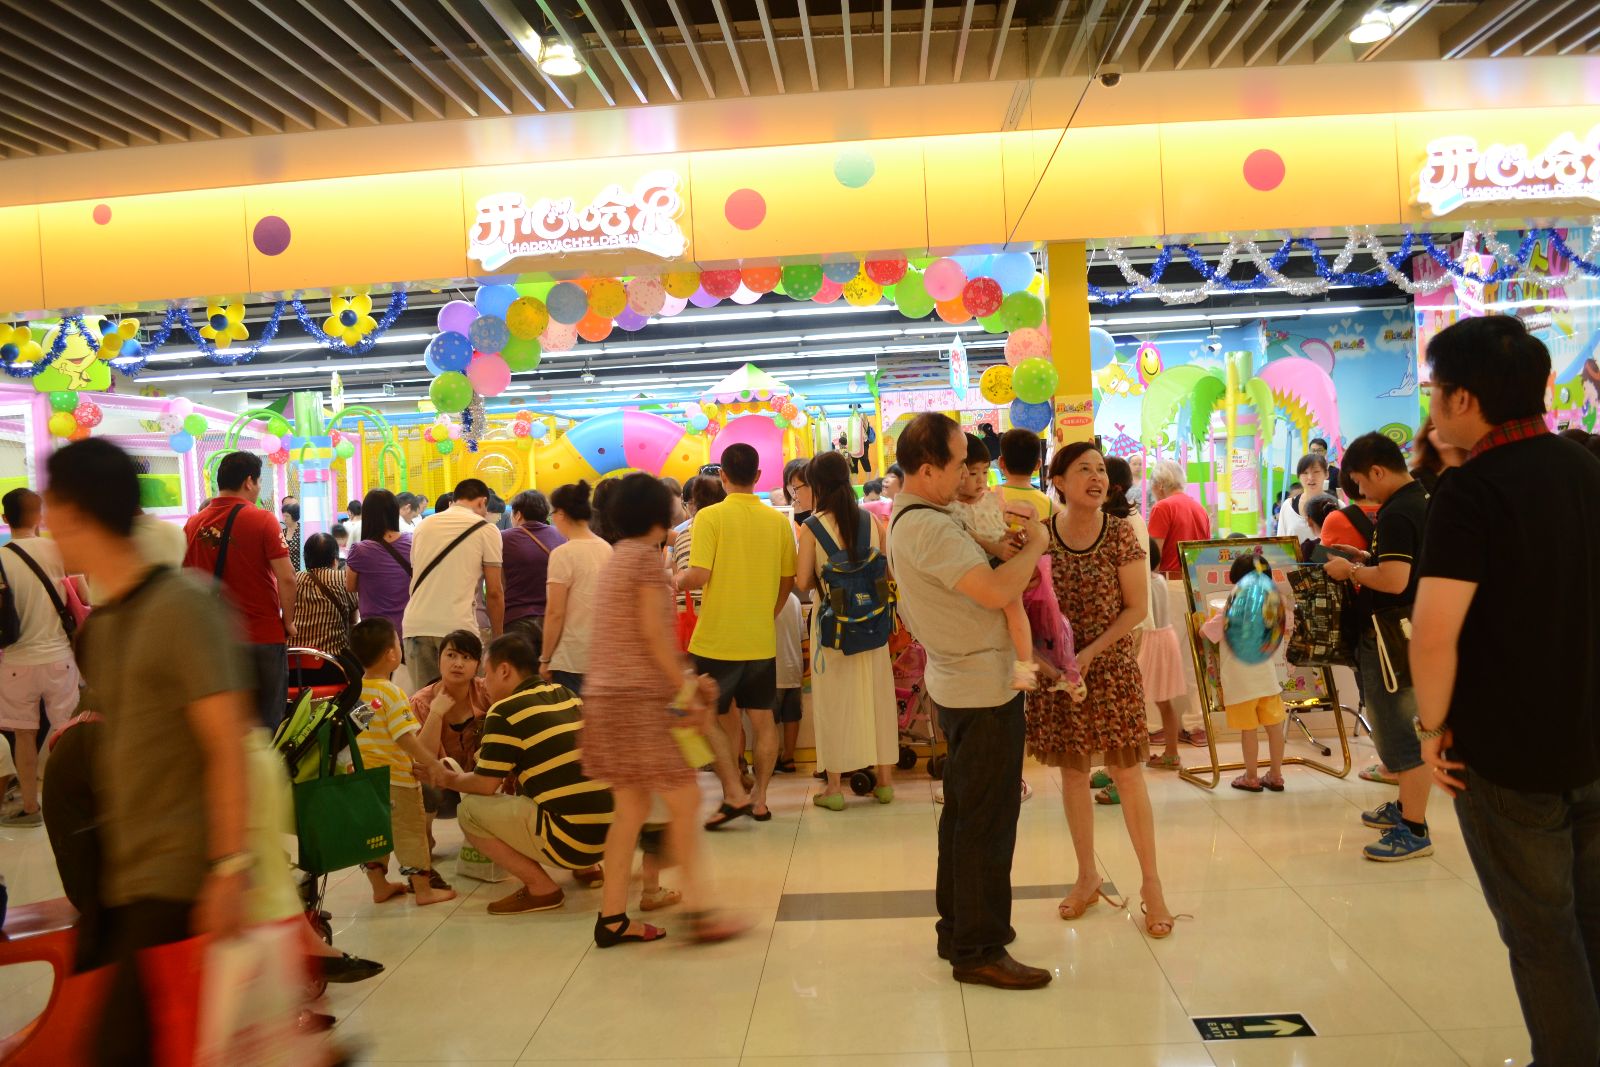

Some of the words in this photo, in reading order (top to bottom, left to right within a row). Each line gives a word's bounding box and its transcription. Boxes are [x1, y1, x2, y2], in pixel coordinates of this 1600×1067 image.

[509, 240, 557, 254] HAPPY
[562, 233, 639, 250] CHILDREN
[1207, 1022, 1224, 1038] EXIT
[1221, 1023, 1239, 1036] 出口
